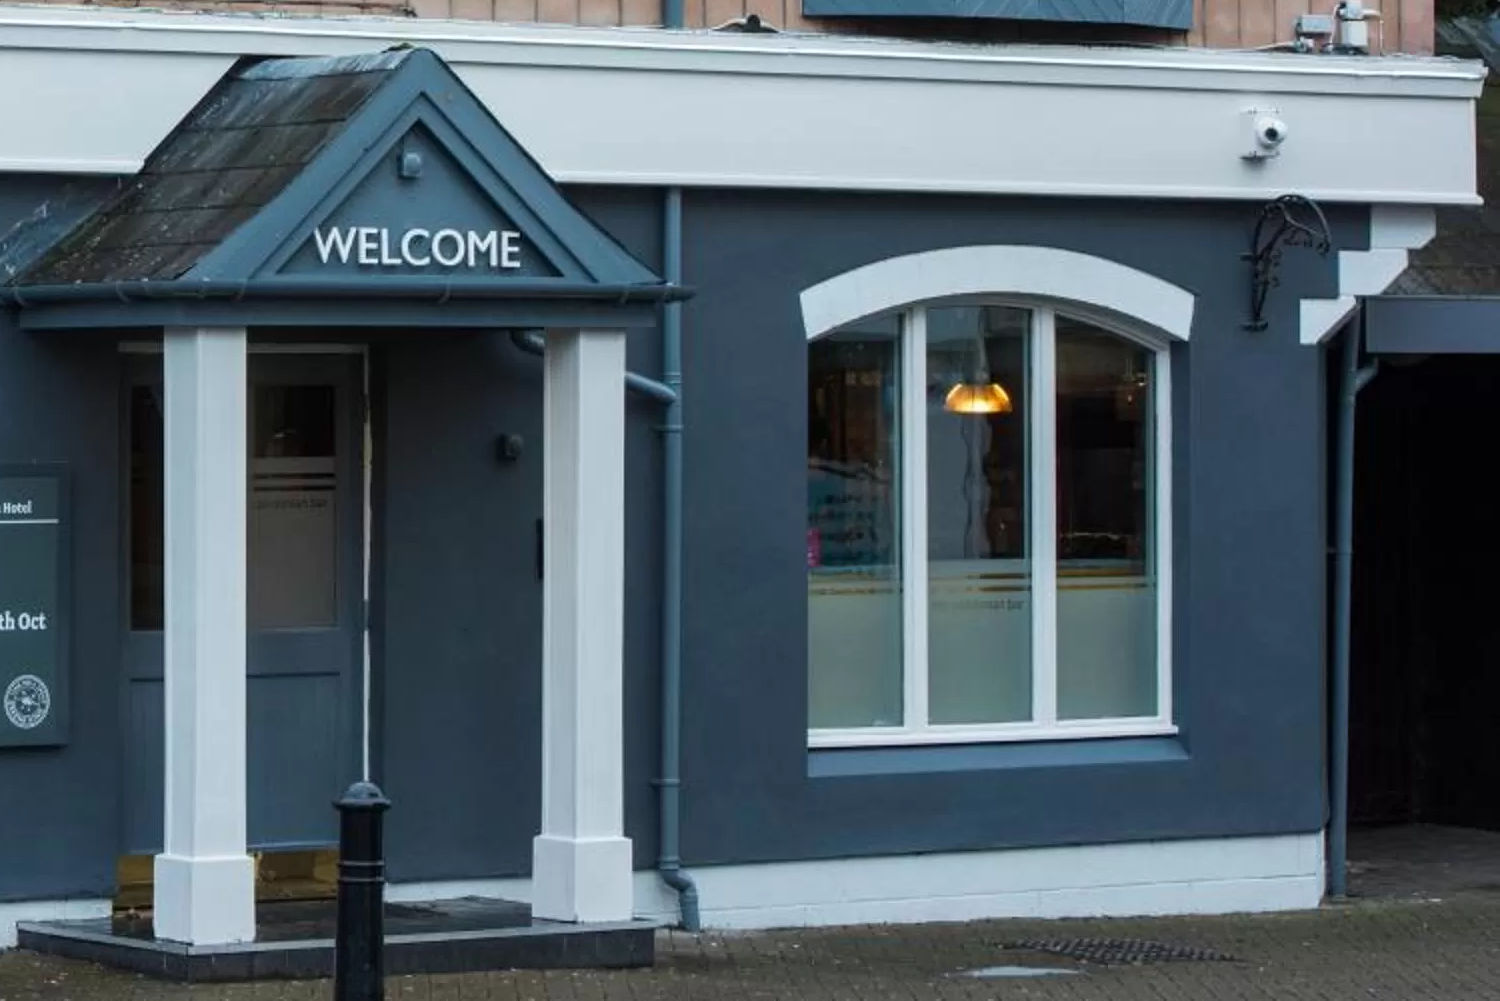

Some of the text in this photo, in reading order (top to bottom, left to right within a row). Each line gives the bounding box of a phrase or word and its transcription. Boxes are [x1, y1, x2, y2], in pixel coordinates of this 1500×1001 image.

[314, 226, 521, 268] WELCOME
[3, 500, 32, 515] Hotel
[18, 611, 46, 631] Oct
